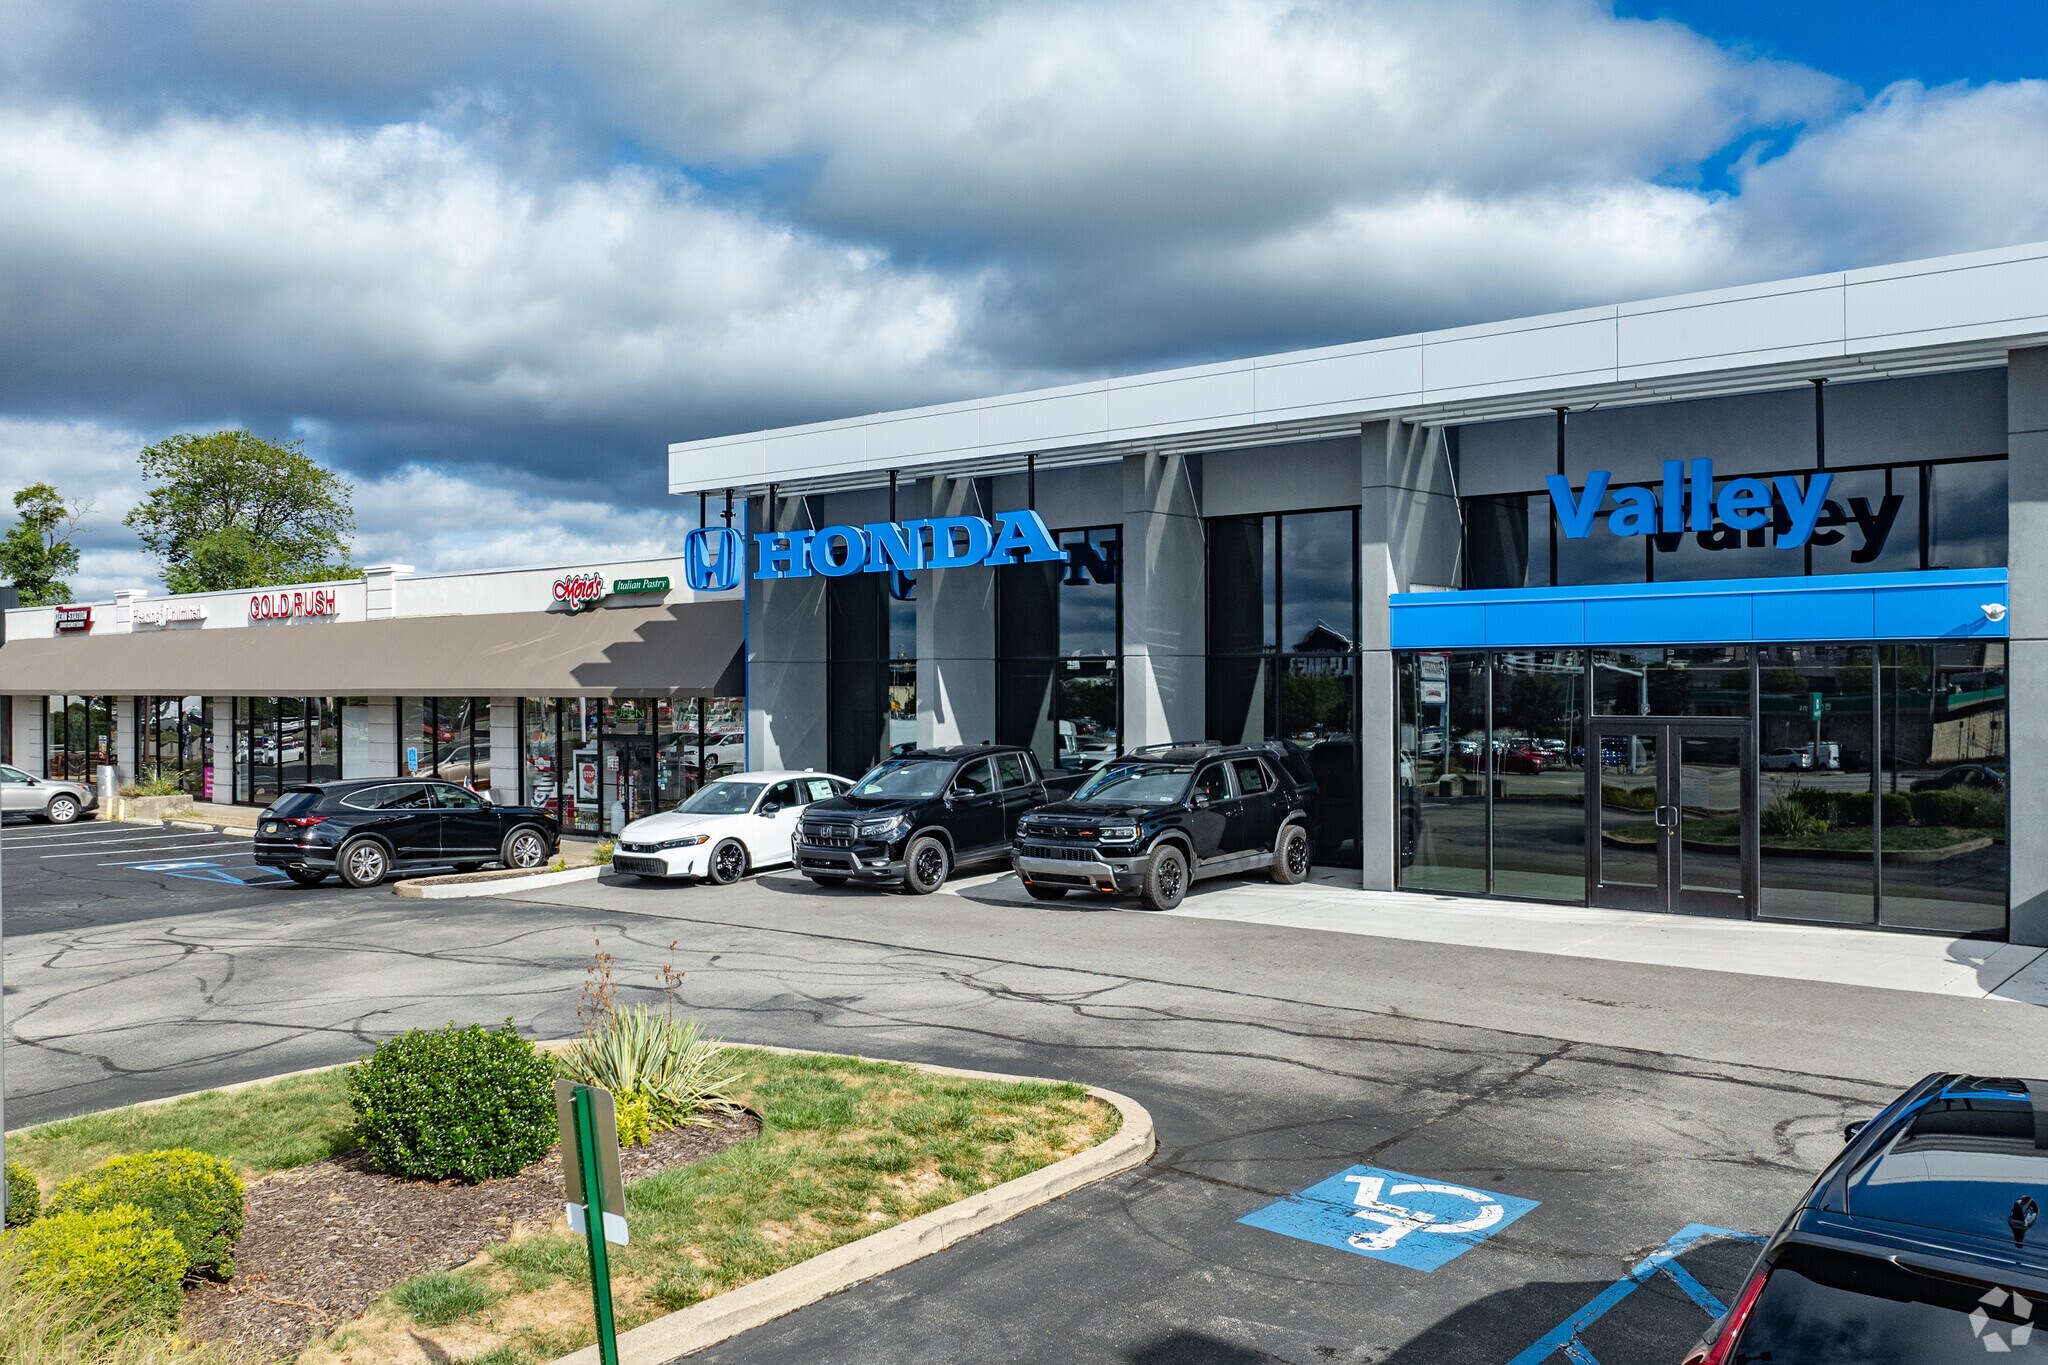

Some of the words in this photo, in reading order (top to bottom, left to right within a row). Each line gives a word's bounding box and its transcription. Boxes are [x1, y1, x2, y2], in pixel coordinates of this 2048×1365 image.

[1545, 457, 1834, 549] Valley
[753, 509, 1068, 579] HONDA
[617, 580, 640, 590] Italian
[642, 579, 667, 589] Pastry
[250, 593, 290, 620] GOLD
[293, 590, 335, 617] RUSH
[614, 708, 645, 718] OPEN
[583, 770, 595, 778] STOP
